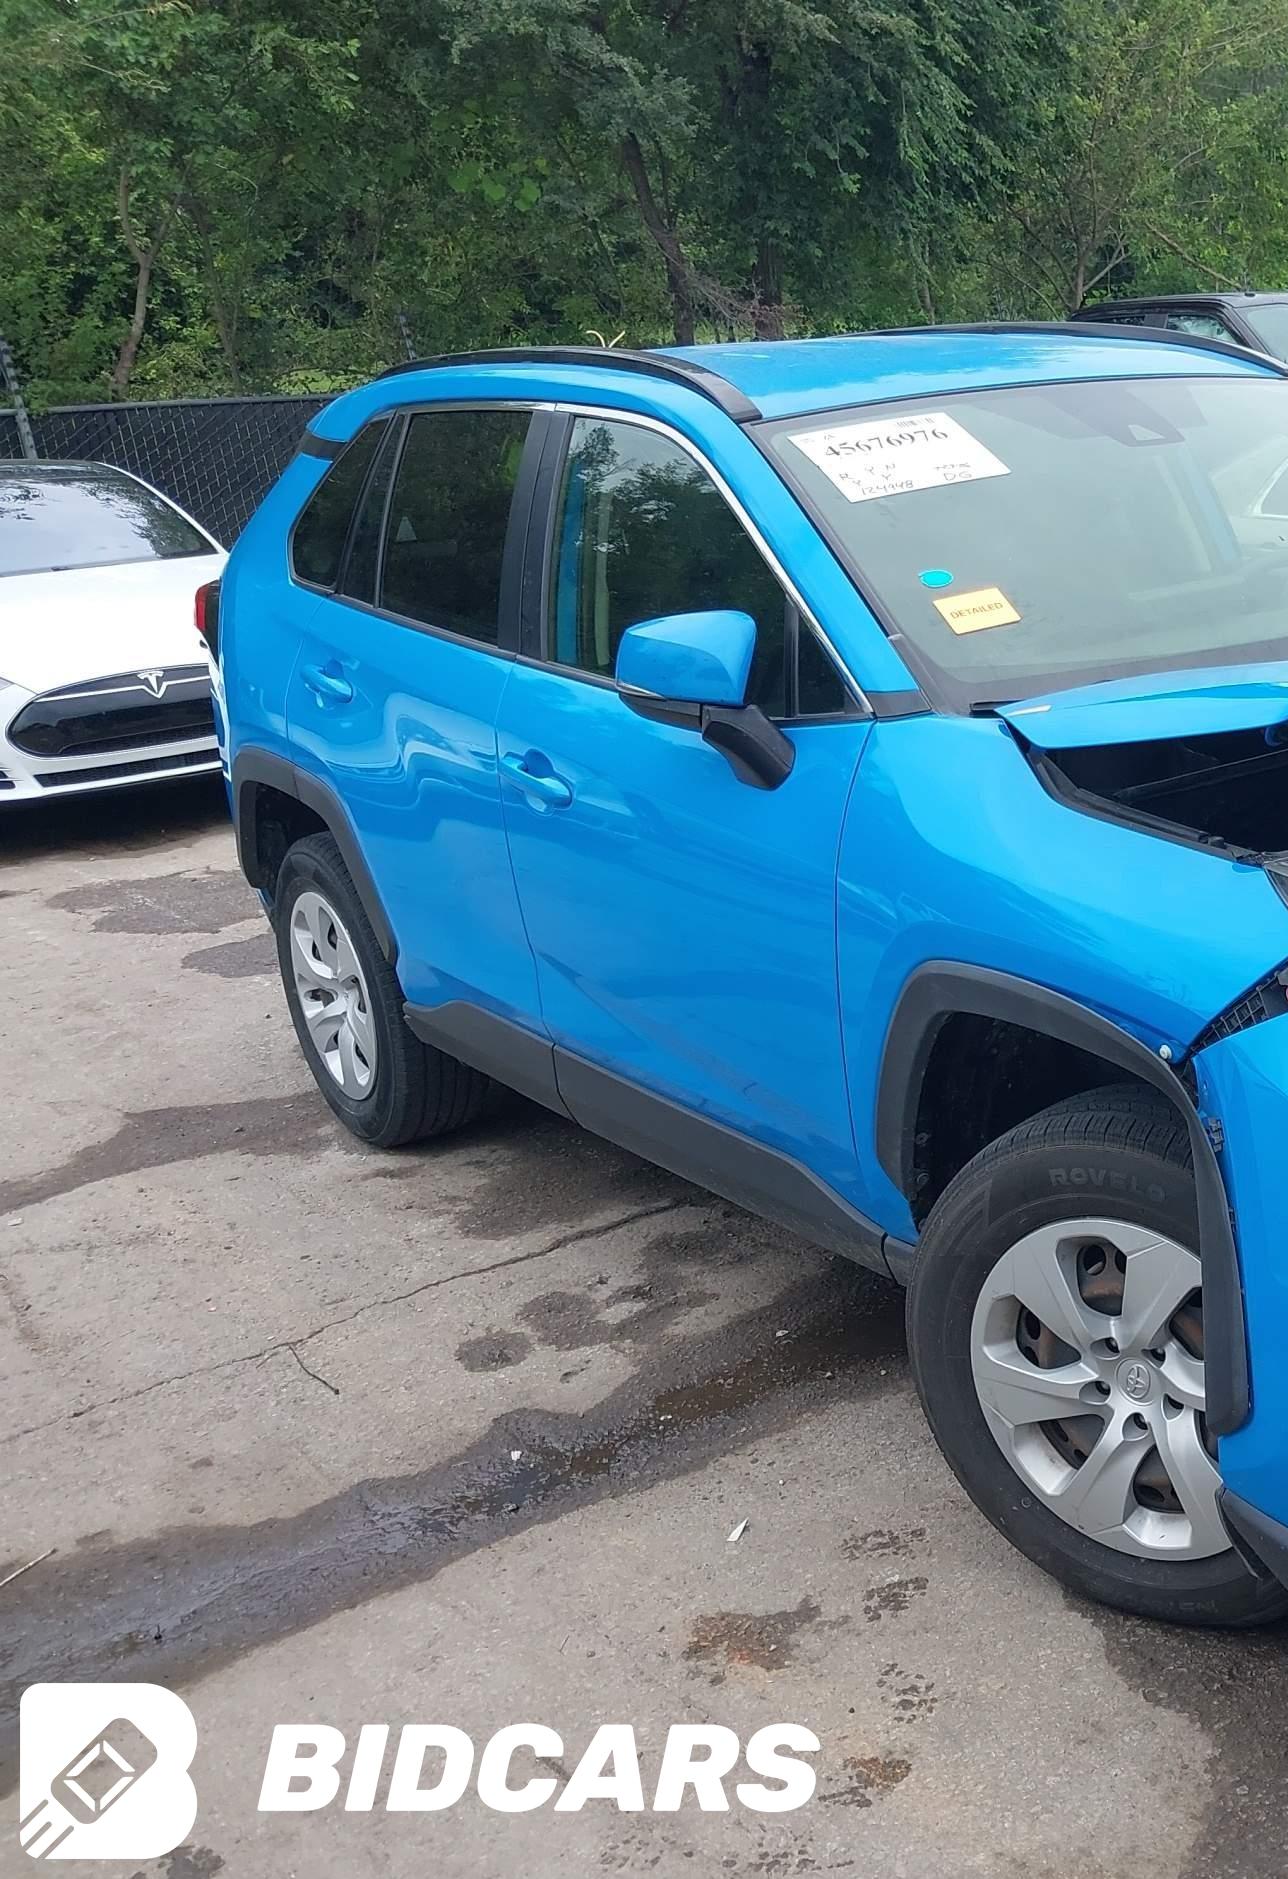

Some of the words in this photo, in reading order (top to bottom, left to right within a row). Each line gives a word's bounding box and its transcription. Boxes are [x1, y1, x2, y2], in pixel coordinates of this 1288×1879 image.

[825, 428, 949, 457] 45676976
[949, 602, 1004, 619] DETAILED
[1049, 1166, 1167, 1201] ROVELO
